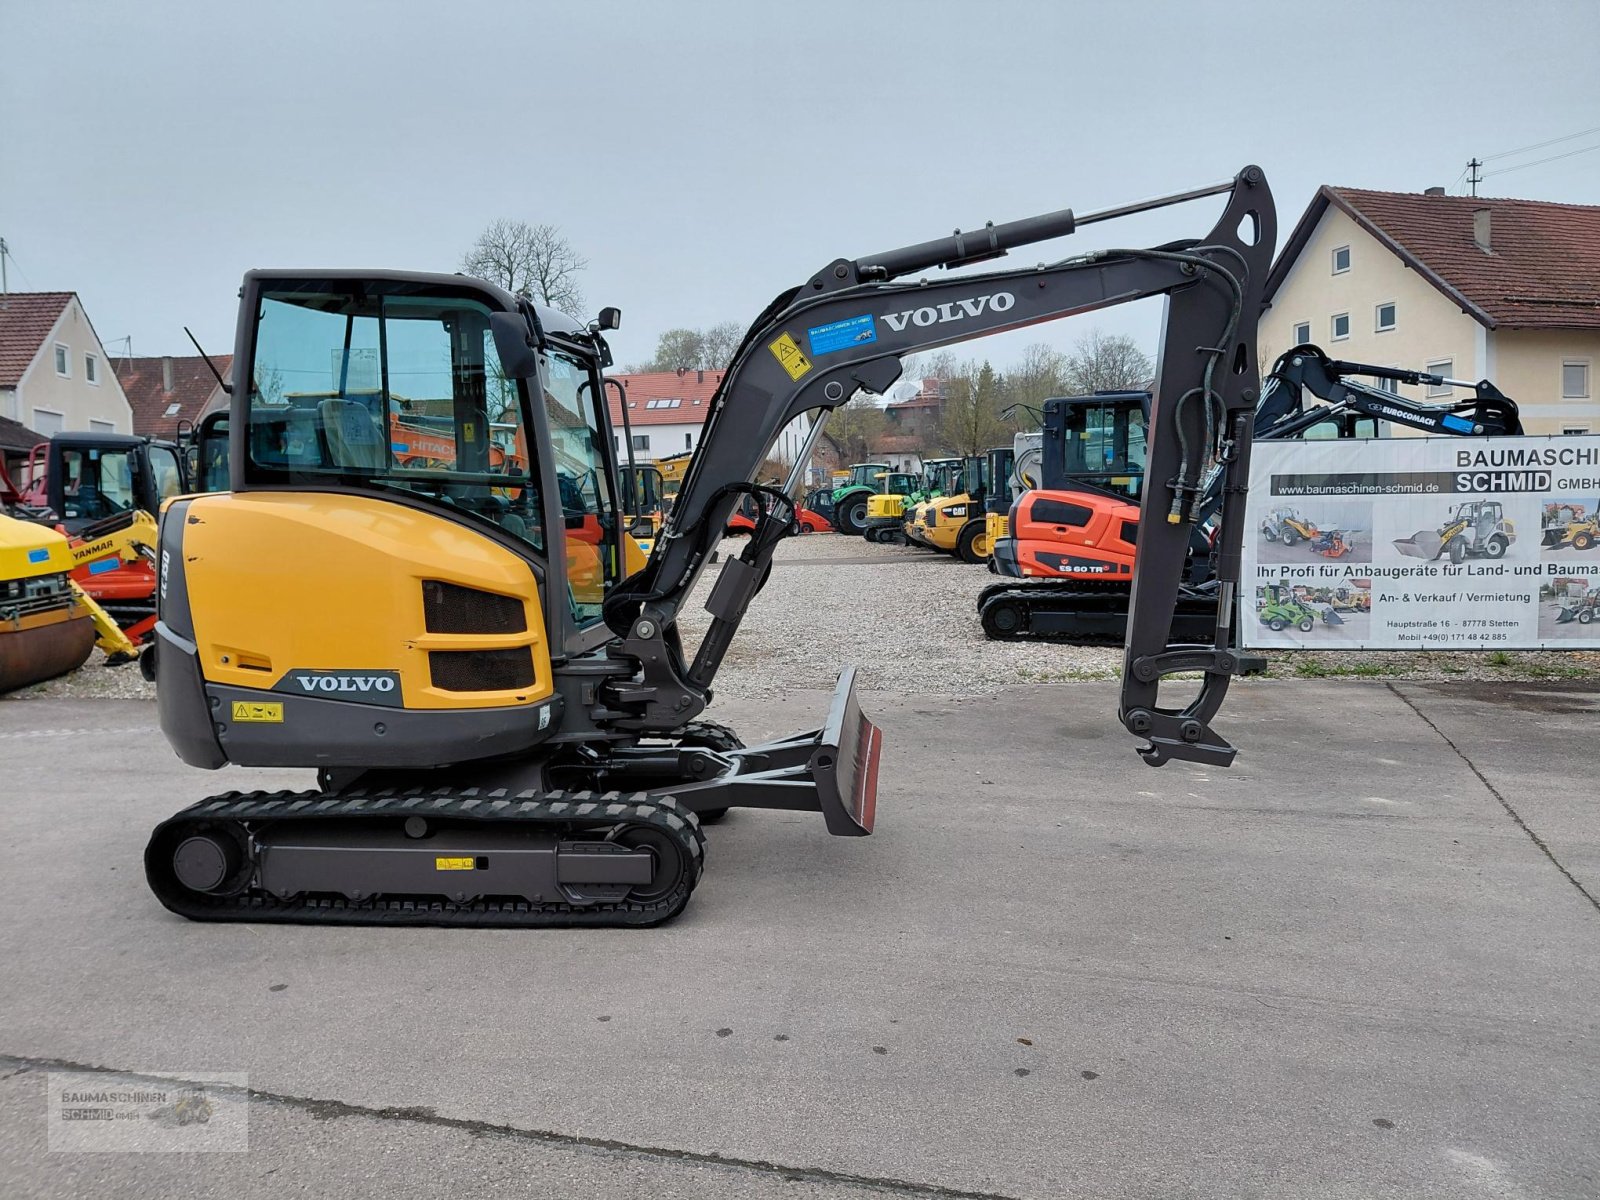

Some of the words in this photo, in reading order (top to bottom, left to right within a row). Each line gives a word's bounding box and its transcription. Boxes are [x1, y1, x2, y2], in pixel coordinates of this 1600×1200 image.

[880, 292, 1015, 332] VOLVO
[1382, 406, 1436, 426] EUROCOMACH
[1457, 448, 1599, 467] BAUMASCHI
[1278, 483, 1439, 495] www.baumaschinen-schmid.de
[1456, 472, 1551, 492] SCHMID
[1557, 478, 1600, 489] GMBH
[952, 507, 966, 516] CAT
[73, 540, 114, 560] YANMAR
[1257, 566, 1276, 577] Ihr
[1281, 565, 1315, 577] Profi
[1320, 565, 1340, 577] für
[1343, 565, 1438, 579] Anbaugeräte
[1443, 564, 1463, 576] für
[1467, 564, 1510, 576] Land-
[1514, 564, 1542, 576] und
[1379, 593, 1399, 602] An-
[1402, 593, 1410, 602] &
[1414, 593, 1457, 602] Verkauf
[1459, 593, 1463, 602] /
[1466, 592, 1531, 604] Vermietung
[1387, 620, 1437, 628] Hauptstraße
[1440, 620, 1450, 628] 16
[1398, 633, 1421, 641] Mobil
[1423, 633, 1449, 642] +49(0)
[1451, 633, 1465, 641] 171
[1467, 633, 1477, 641] 48
[1479, 633, 1490, 641] 42
[1492, 633, 1507, 641] 885
[297, 676, 395, 692] VOLVO
